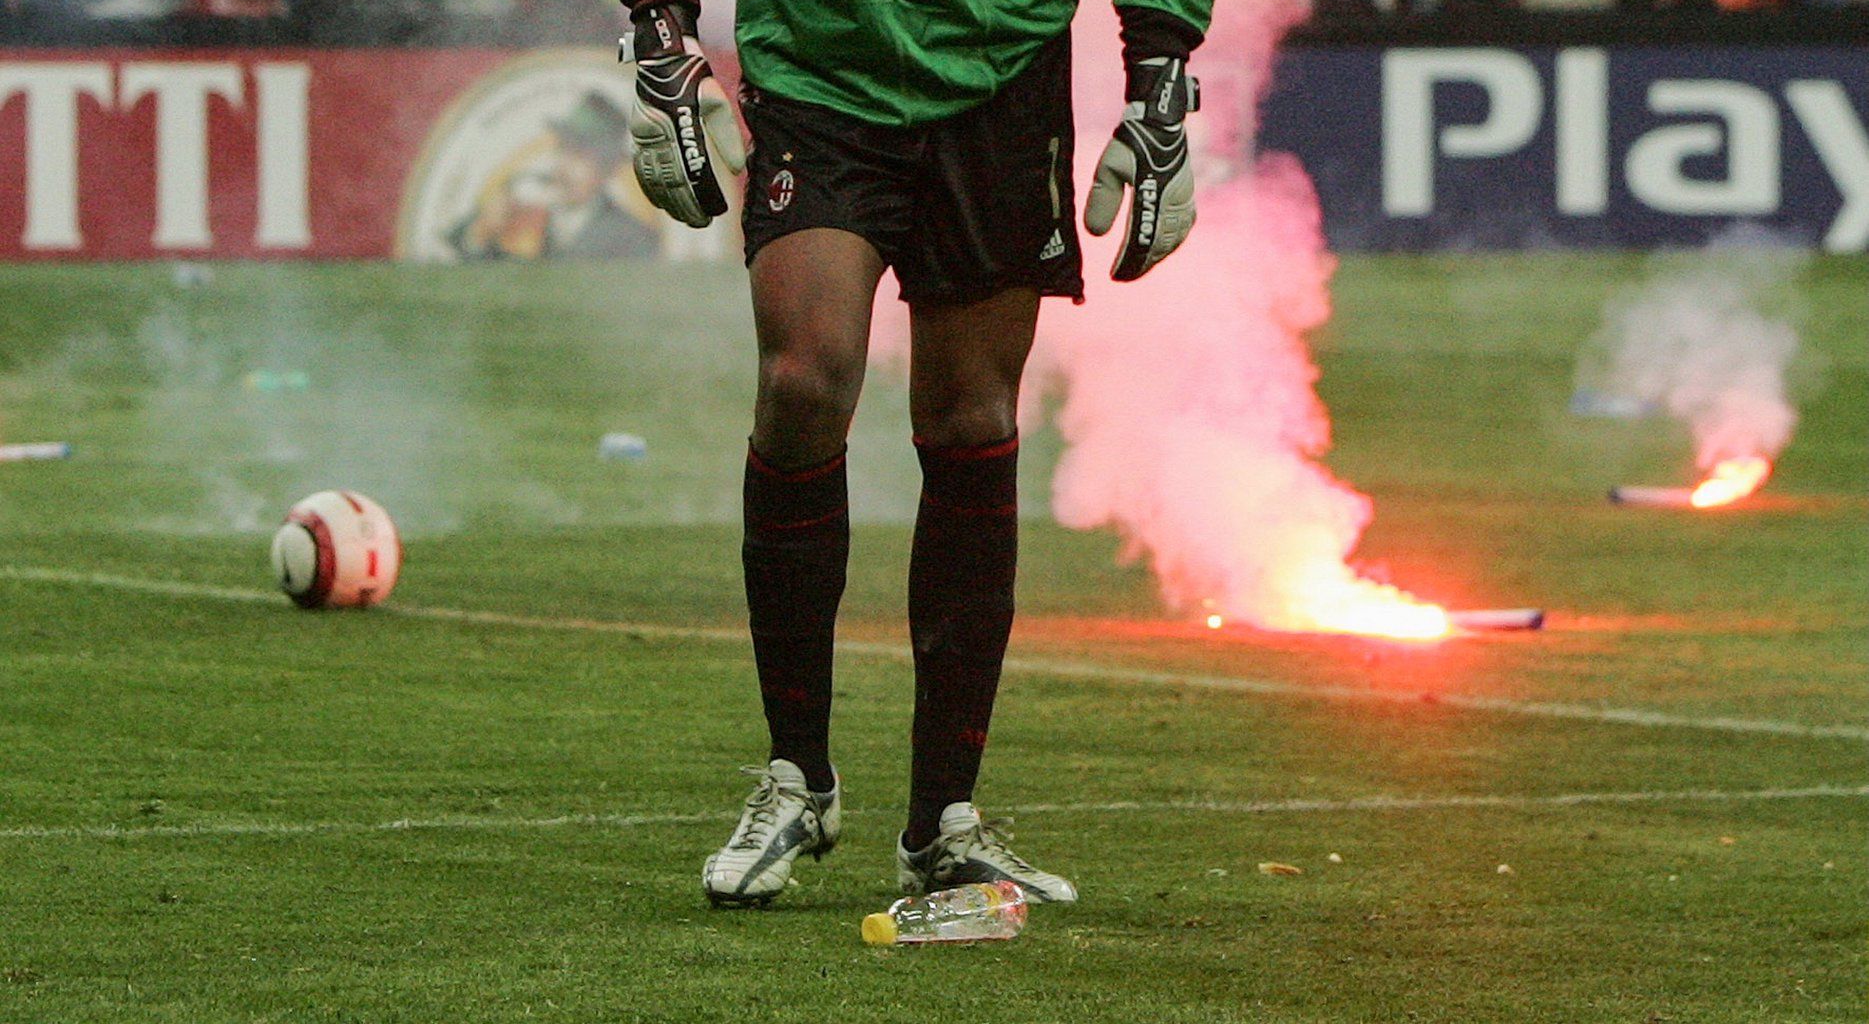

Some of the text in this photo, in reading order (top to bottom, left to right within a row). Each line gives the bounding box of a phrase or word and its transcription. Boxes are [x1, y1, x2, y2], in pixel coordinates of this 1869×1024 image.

[0, 61, 311, 249] TTI
[677, 106, 706, 173] reusch
[1381, 47, 1869, 253] Play
[1138, 178, 1158, 246] reusch
